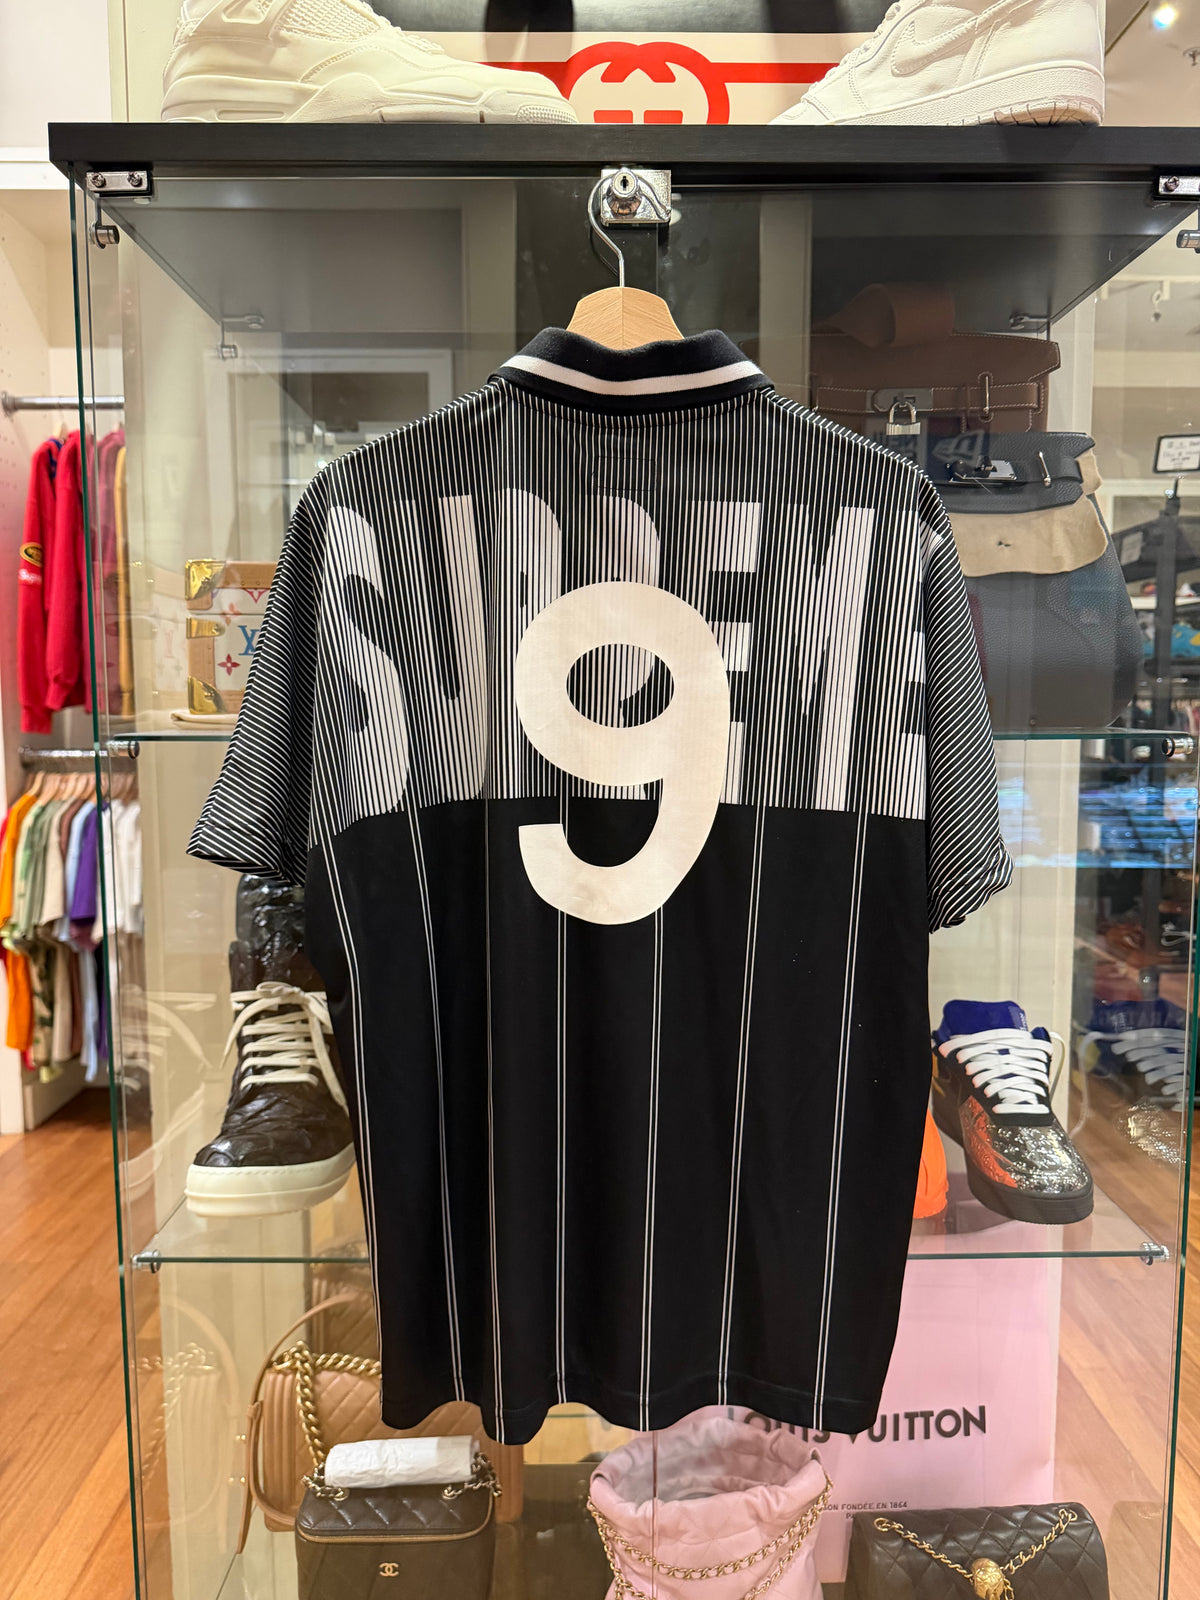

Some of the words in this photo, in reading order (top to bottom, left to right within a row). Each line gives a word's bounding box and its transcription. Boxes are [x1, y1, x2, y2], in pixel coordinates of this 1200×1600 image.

[314, 487, 926, 820] SUPREME
[514, 581, 731, 926] 9
[849, 1405, 987, 1444] UITTON
